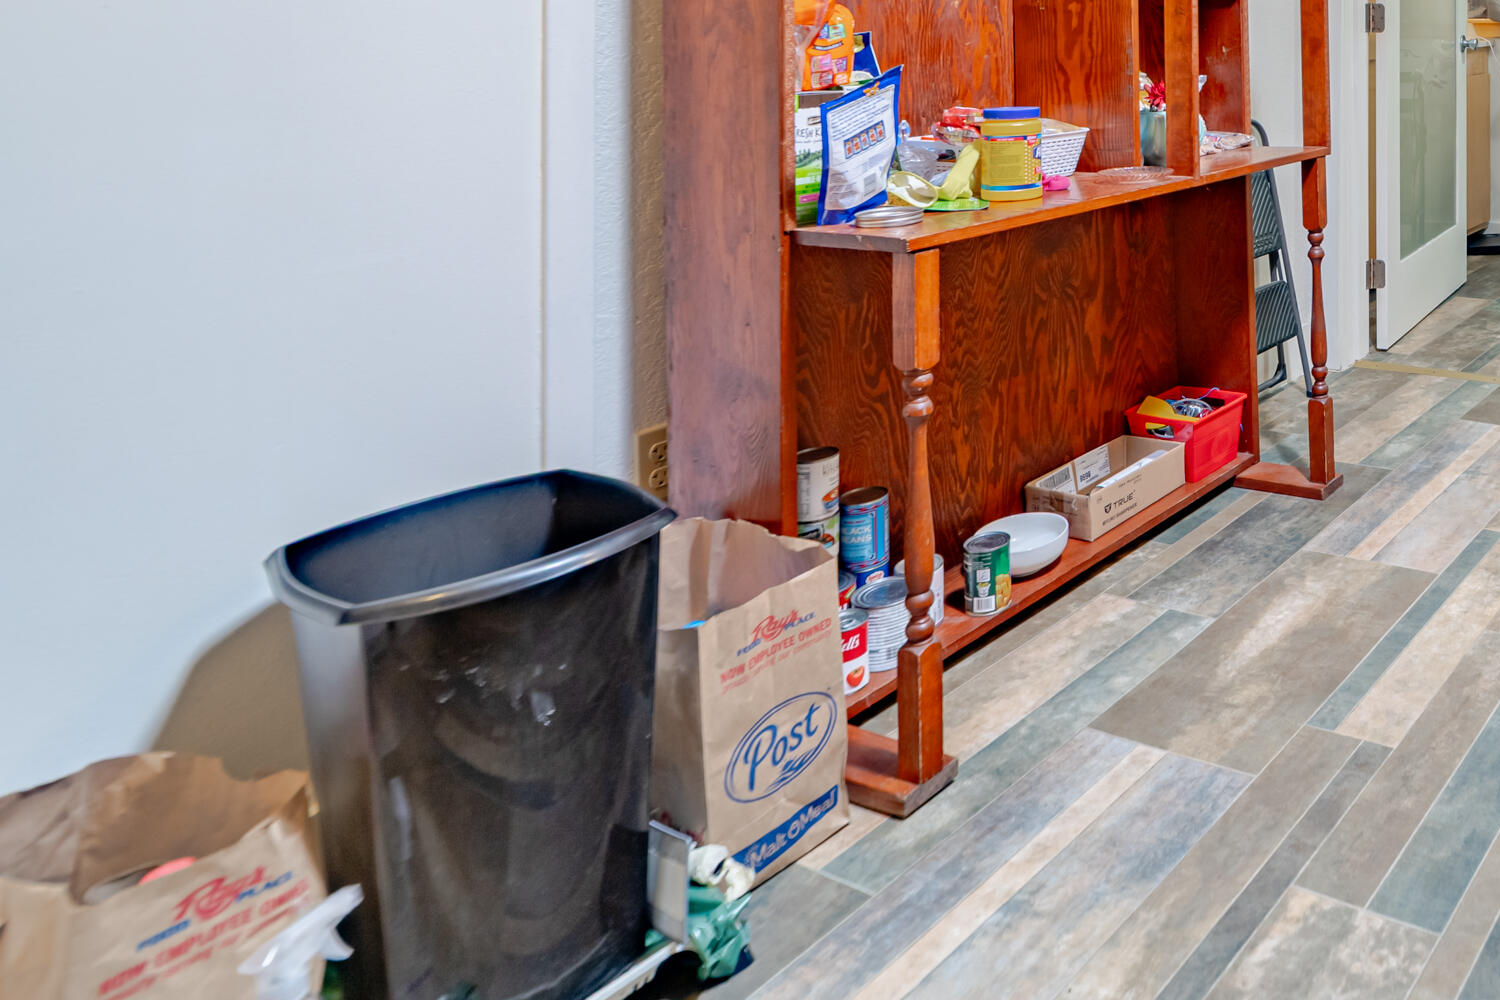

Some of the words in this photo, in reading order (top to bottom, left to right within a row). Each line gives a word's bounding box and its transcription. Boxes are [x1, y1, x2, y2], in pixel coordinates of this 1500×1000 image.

[1113, 491, 1134, 510] TRUE
[748, 635, 796, 670] EMPLOYEE
[797, 617, 832, 641] OWNED
[743, 702, 823, 792] Post
